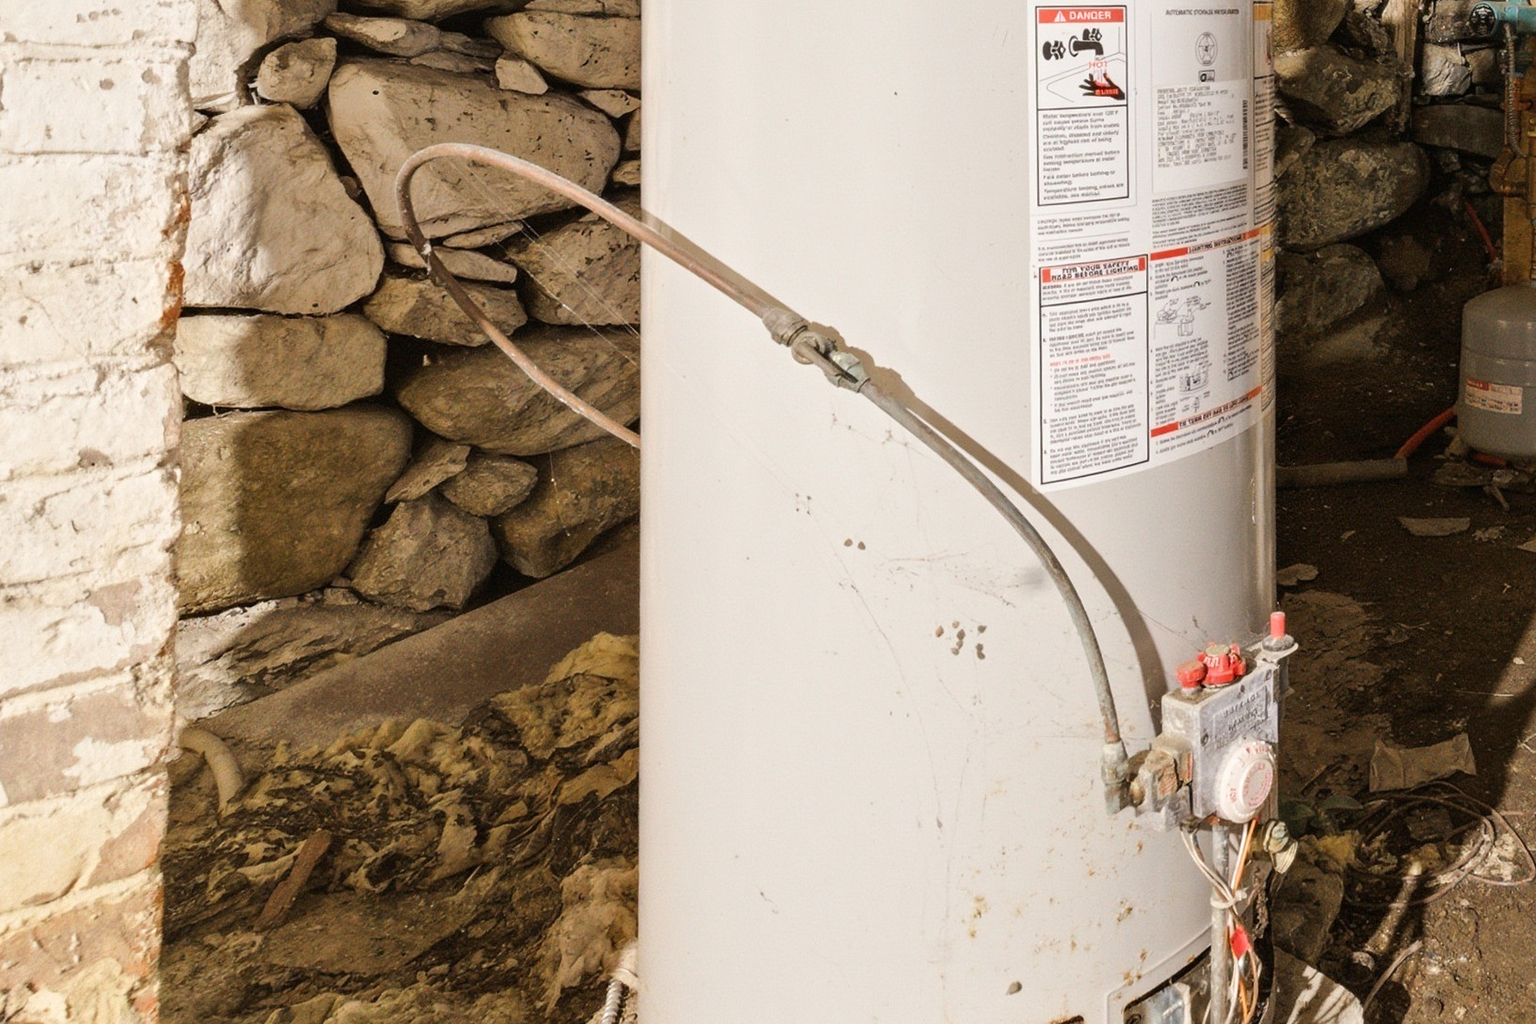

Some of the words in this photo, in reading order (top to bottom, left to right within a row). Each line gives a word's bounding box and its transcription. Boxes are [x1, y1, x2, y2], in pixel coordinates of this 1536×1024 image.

[1069, 11, 1112, 21] DANGER
[1103, 260, 1130, 270] SAFETY
[1106, 265, 1139, 275] LIGHTING
